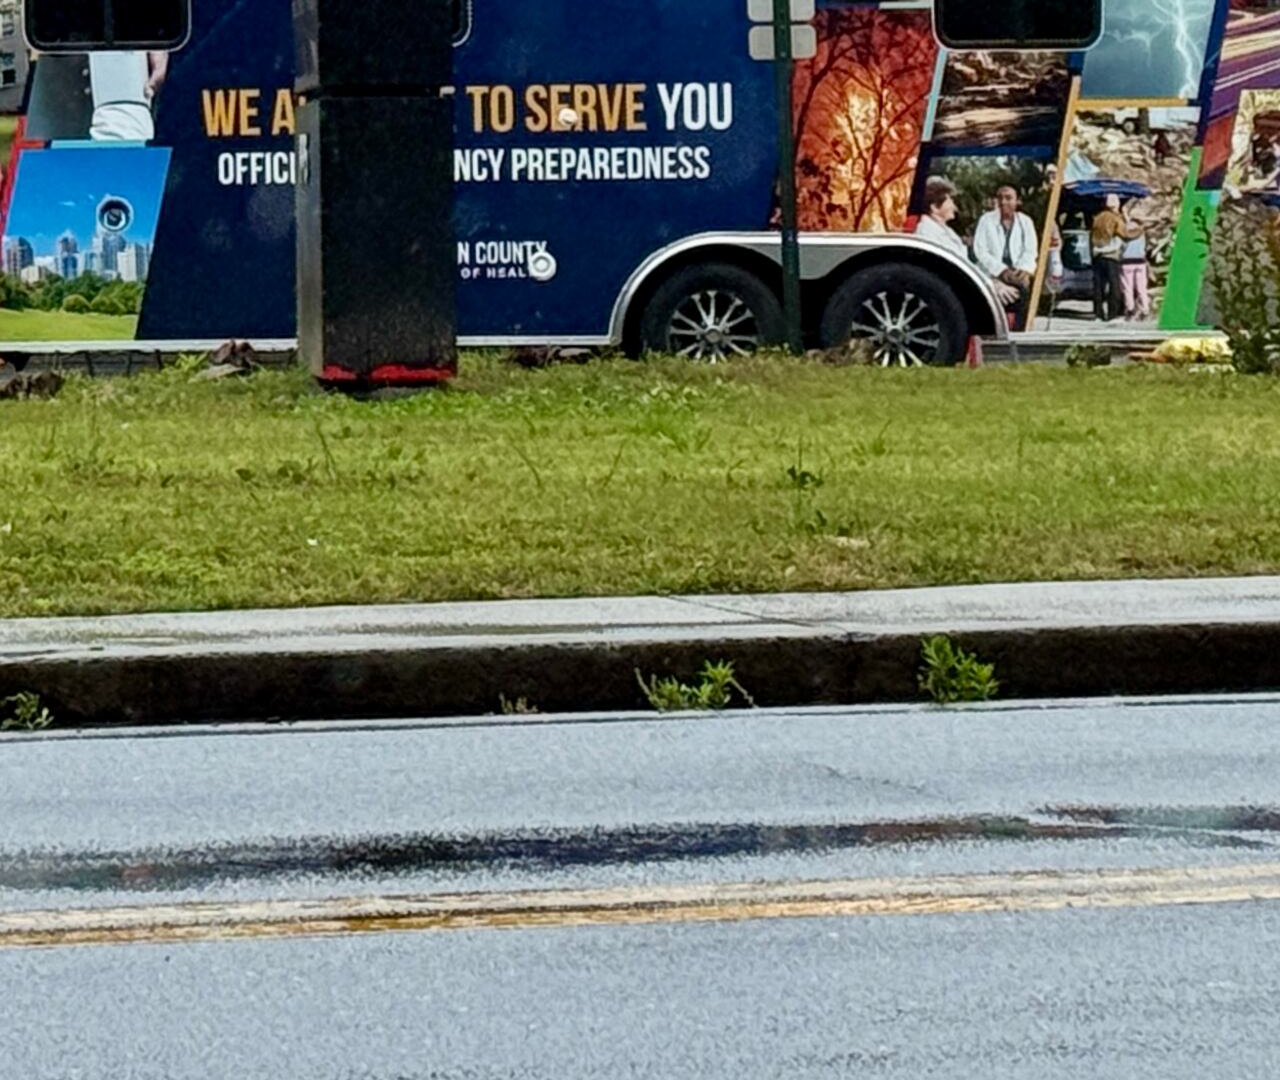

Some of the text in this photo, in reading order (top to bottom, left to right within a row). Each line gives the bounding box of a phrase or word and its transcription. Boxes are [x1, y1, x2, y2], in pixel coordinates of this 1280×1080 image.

[202, 87, 259, 138] WE
[465, 84, 515, 134] TO
[524, 83, 647, 133] SERVE
[657, 82, 733, 131] YOU
[511, 147, 710, 183] PREPAREDNESS
[475, 240, 548, 265] COUNTY
[460, 266, 532, 280] OF HEAL
